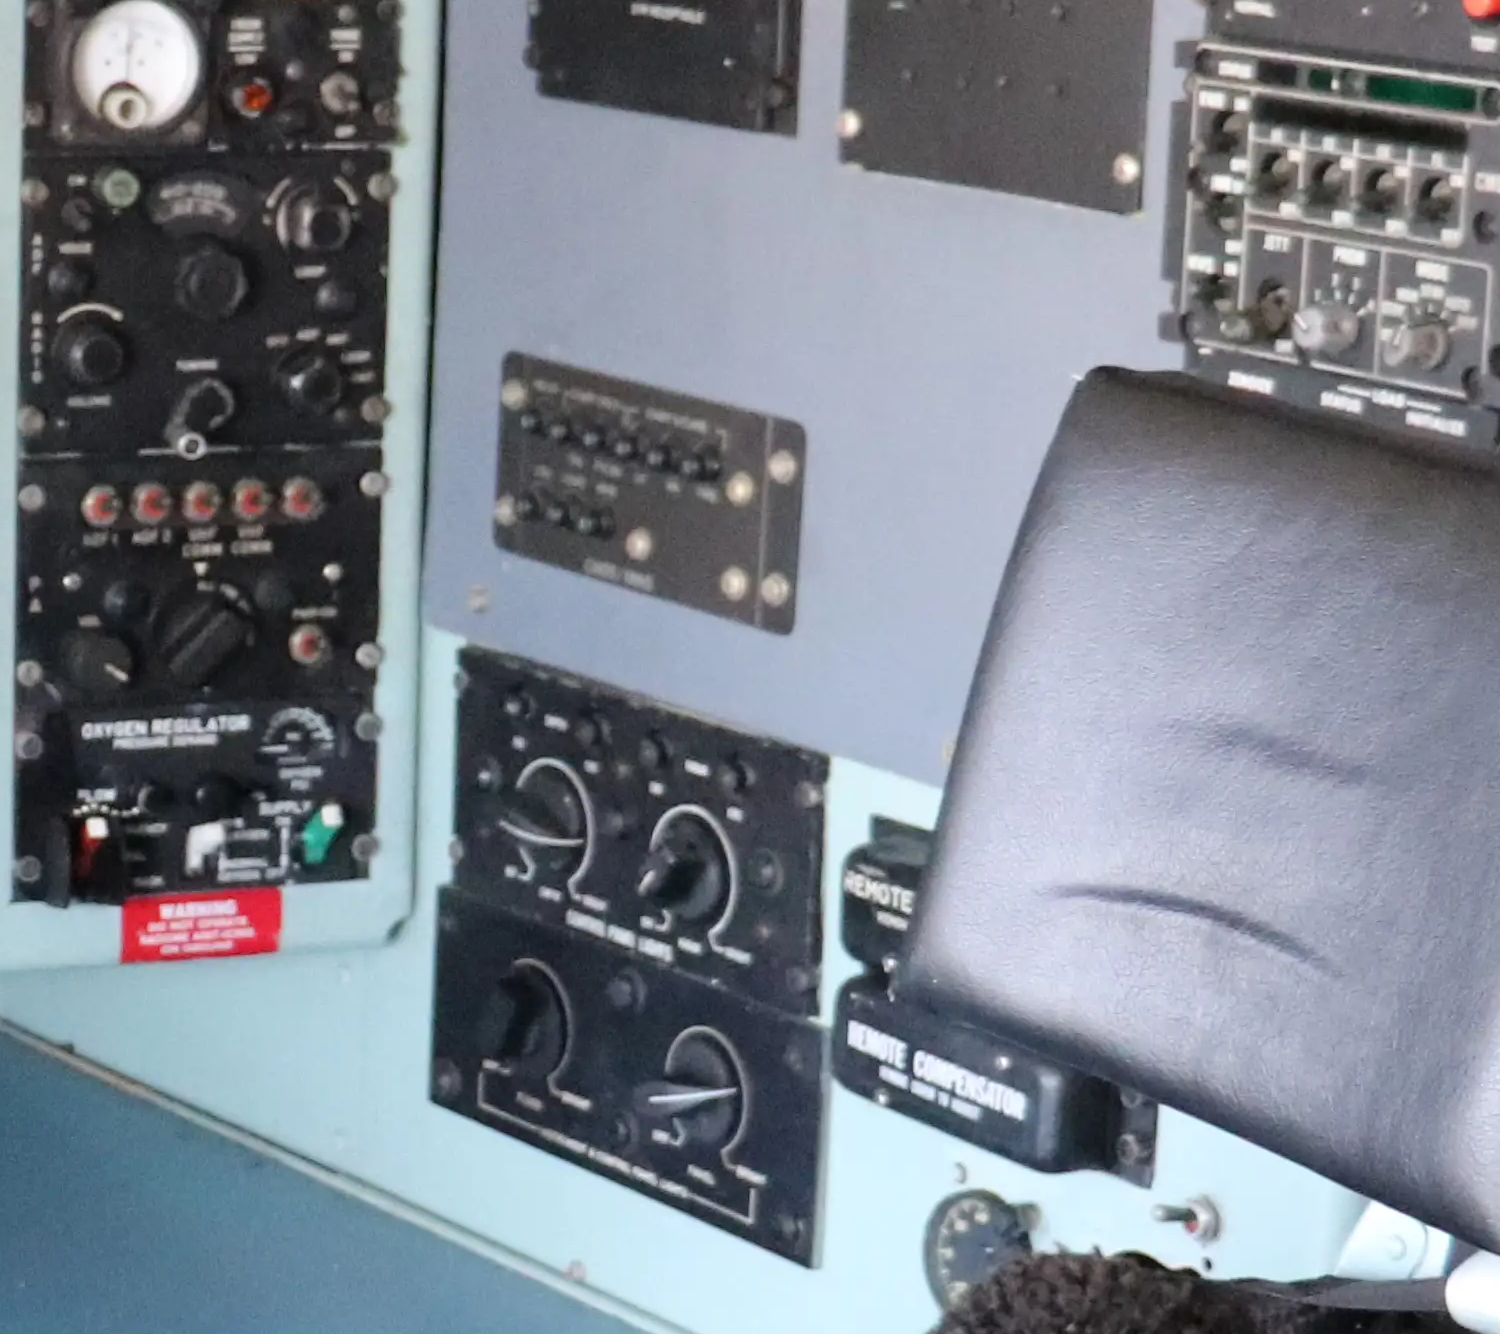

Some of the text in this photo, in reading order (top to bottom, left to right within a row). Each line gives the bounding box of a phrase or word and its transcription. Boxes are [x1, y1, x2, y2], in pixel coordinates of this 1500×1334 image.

[82, 715, 251, 739] OXYGEN REGULATOR
[912, 1049, 1028, 1121] COMPENSATOR
